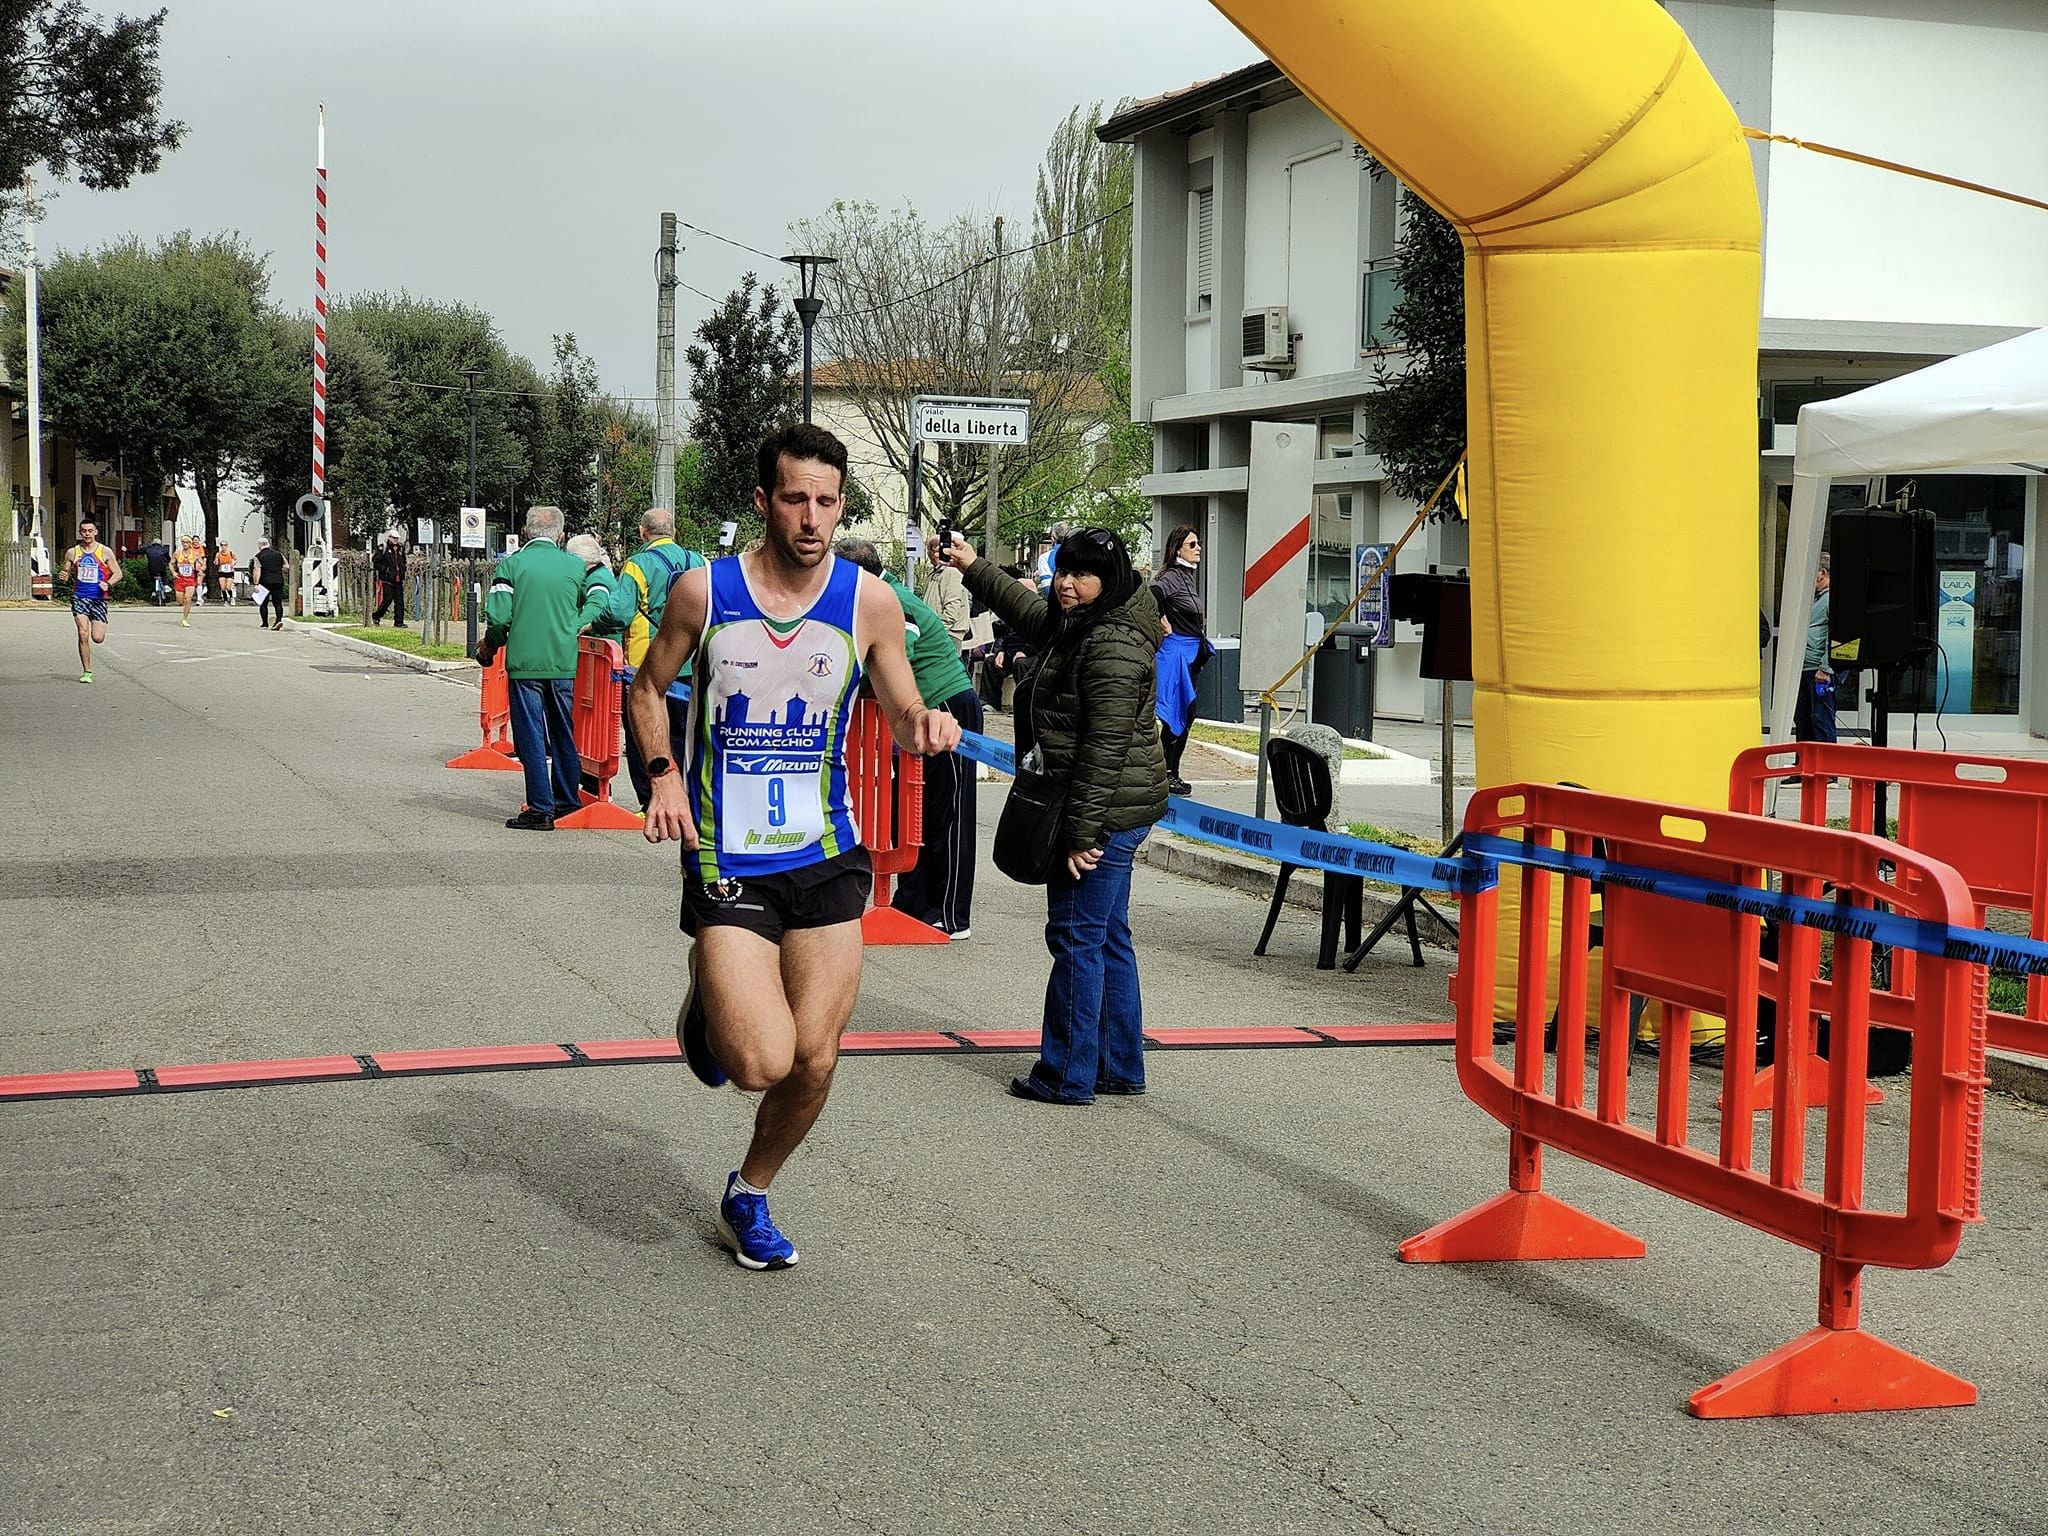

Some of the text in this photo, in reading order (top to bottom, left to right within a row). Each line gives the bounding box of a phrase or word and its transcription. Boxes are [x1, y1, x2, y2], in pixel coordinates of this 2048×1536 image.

[925, 408, 944, 416] viale
[925, 418, 1017, 436] della Liberta
[720, 726, 821, 737] RUNNING CLUB
[726, 738, 814, 747] COMACCHIO
[768, 777, 786, 827] 9
